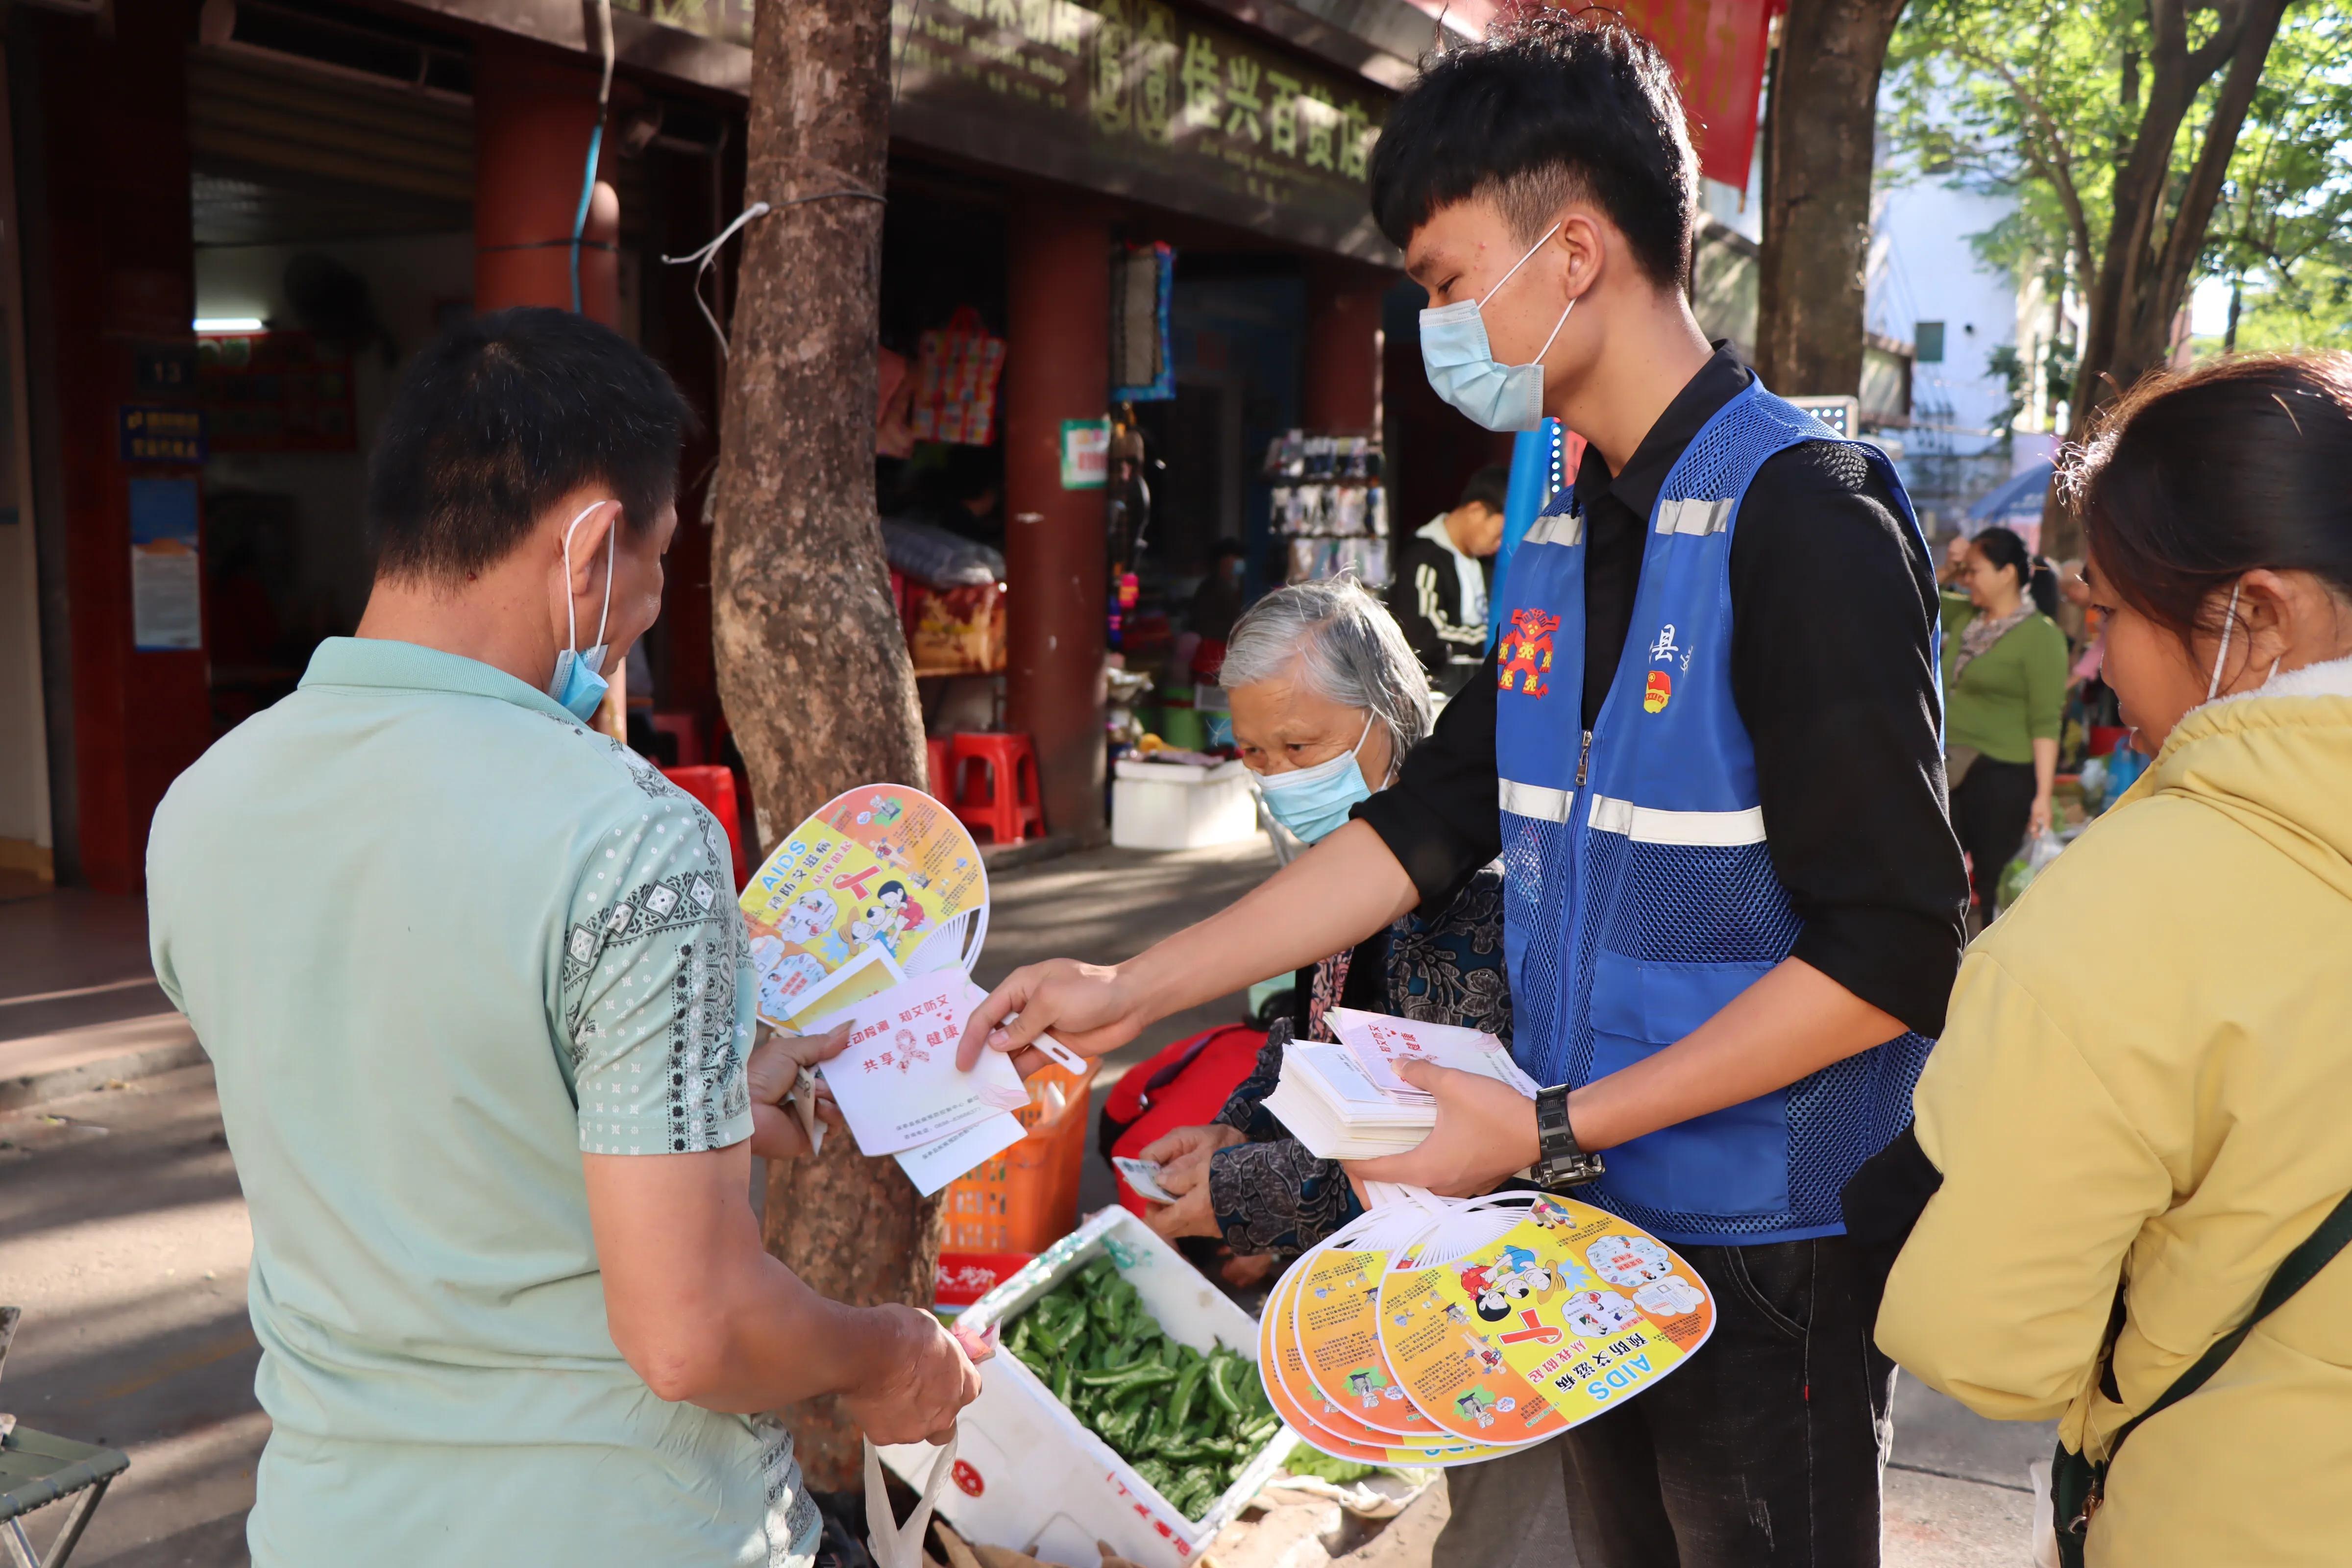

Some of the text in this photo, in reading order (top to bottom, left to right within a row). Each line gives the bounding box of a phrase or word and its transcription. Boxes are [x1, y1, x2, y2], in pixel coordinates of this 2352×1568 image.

[1180, 31, 1371, 183] 佳兴百货店
[762, 841, 806, 892] AIDS
[768, 841, 832, 910] 预防艾滋病
[898, 993, 949, 1024] 知艾防艾
[861, 1022, 960, 1074] 共享 健康
[1528, 1340, 1587, 1383] 从我做起
[1555, 1331, 1649, 1393] 预防艾滋病
[1587, 1353, 1651, 1400] AIDS
